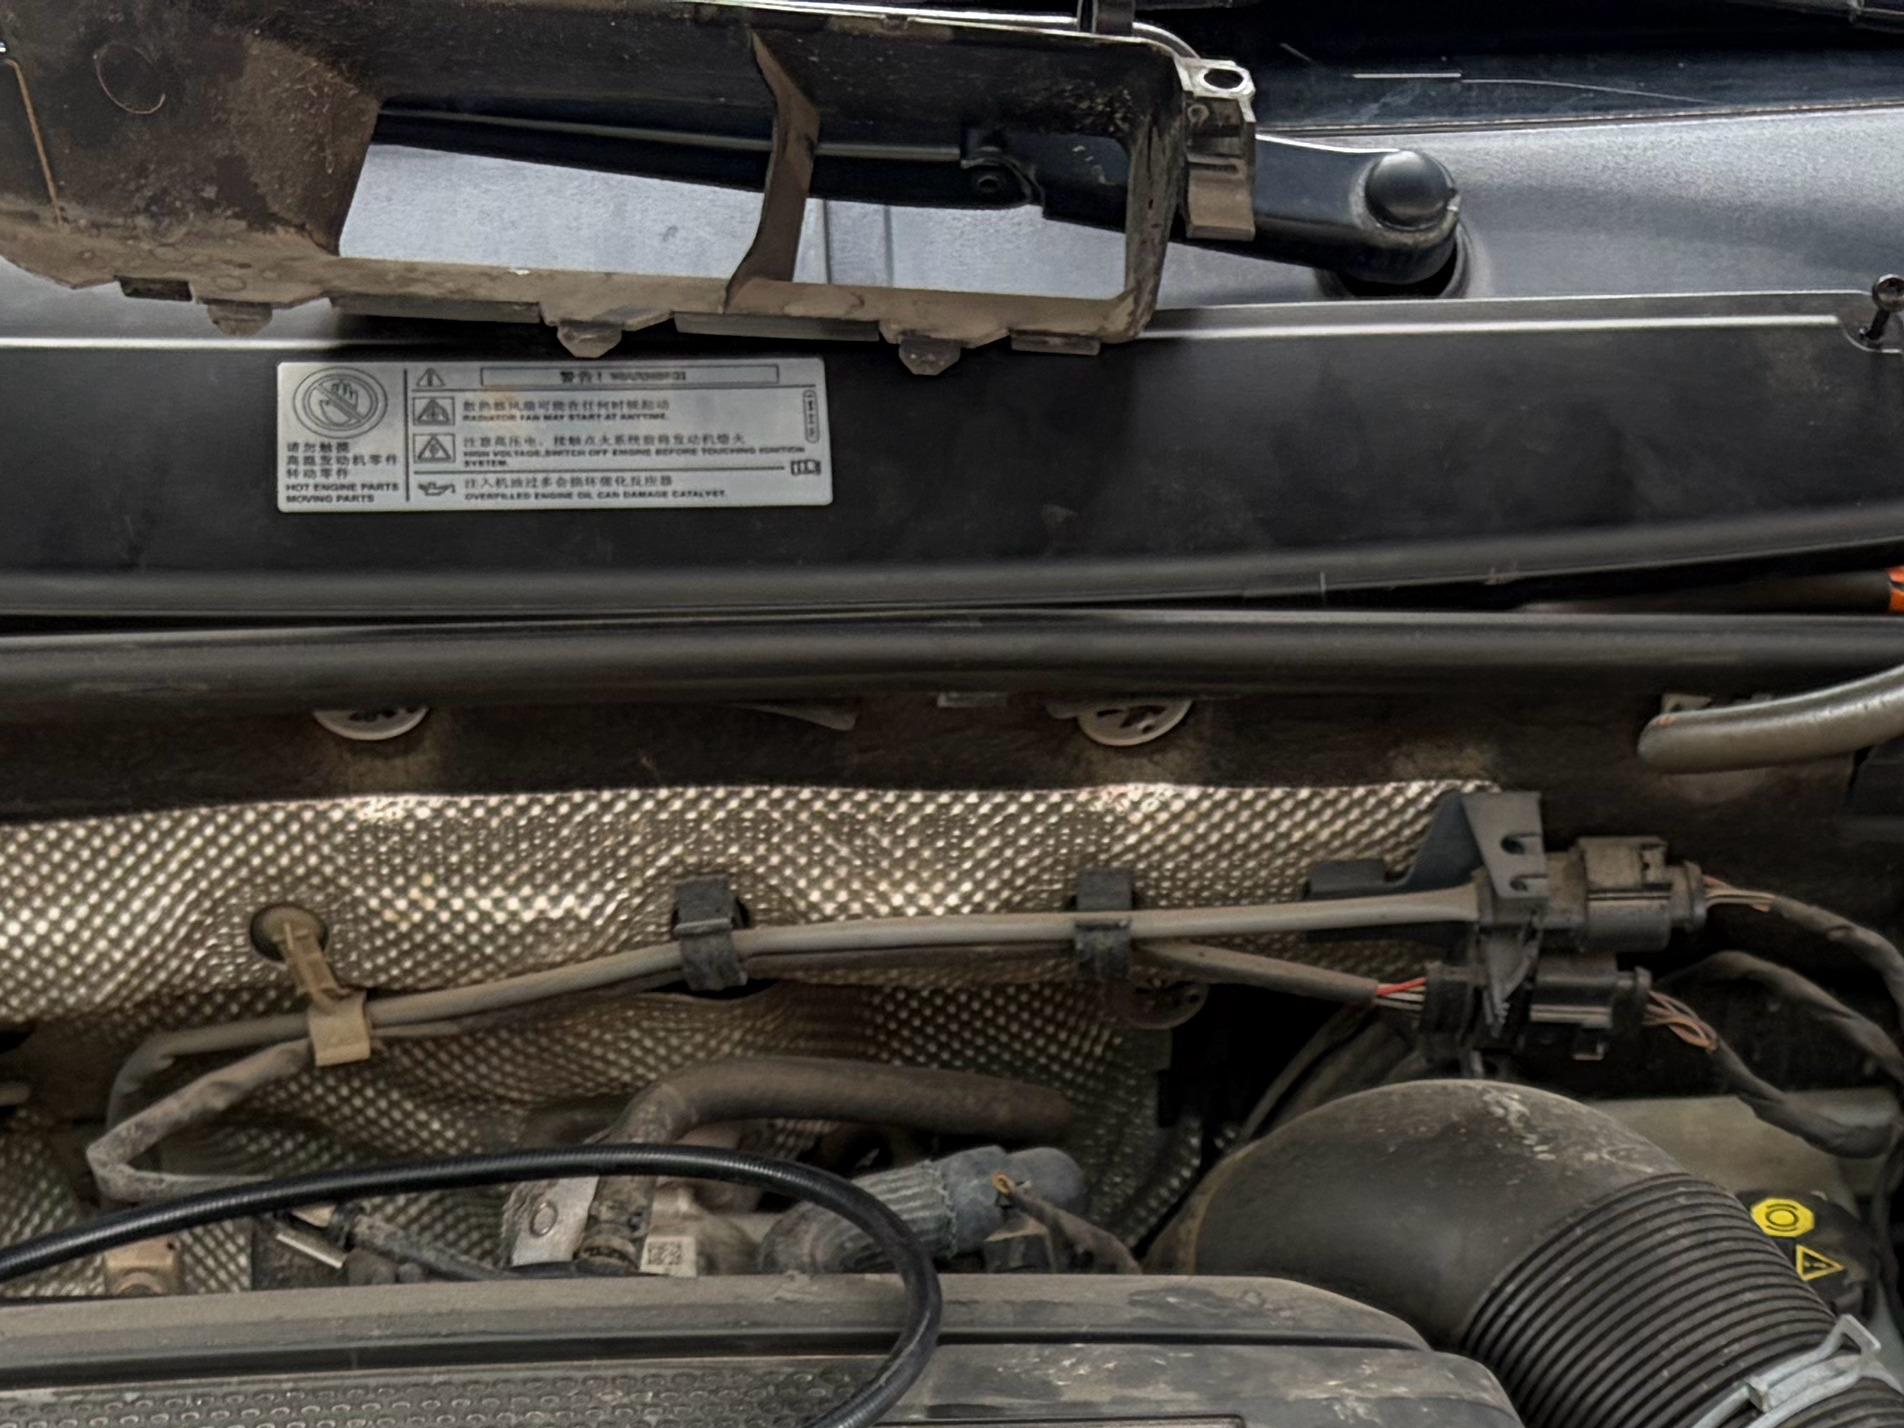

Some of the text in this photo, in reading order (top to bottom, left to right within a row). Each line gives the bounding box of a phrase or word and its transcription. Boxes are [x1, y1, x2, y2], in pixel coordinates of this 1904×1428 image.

[285, 482, 399, 492] HOT ENGINE PARTS
[286, 494, 374, 504] MOVING PARTS
